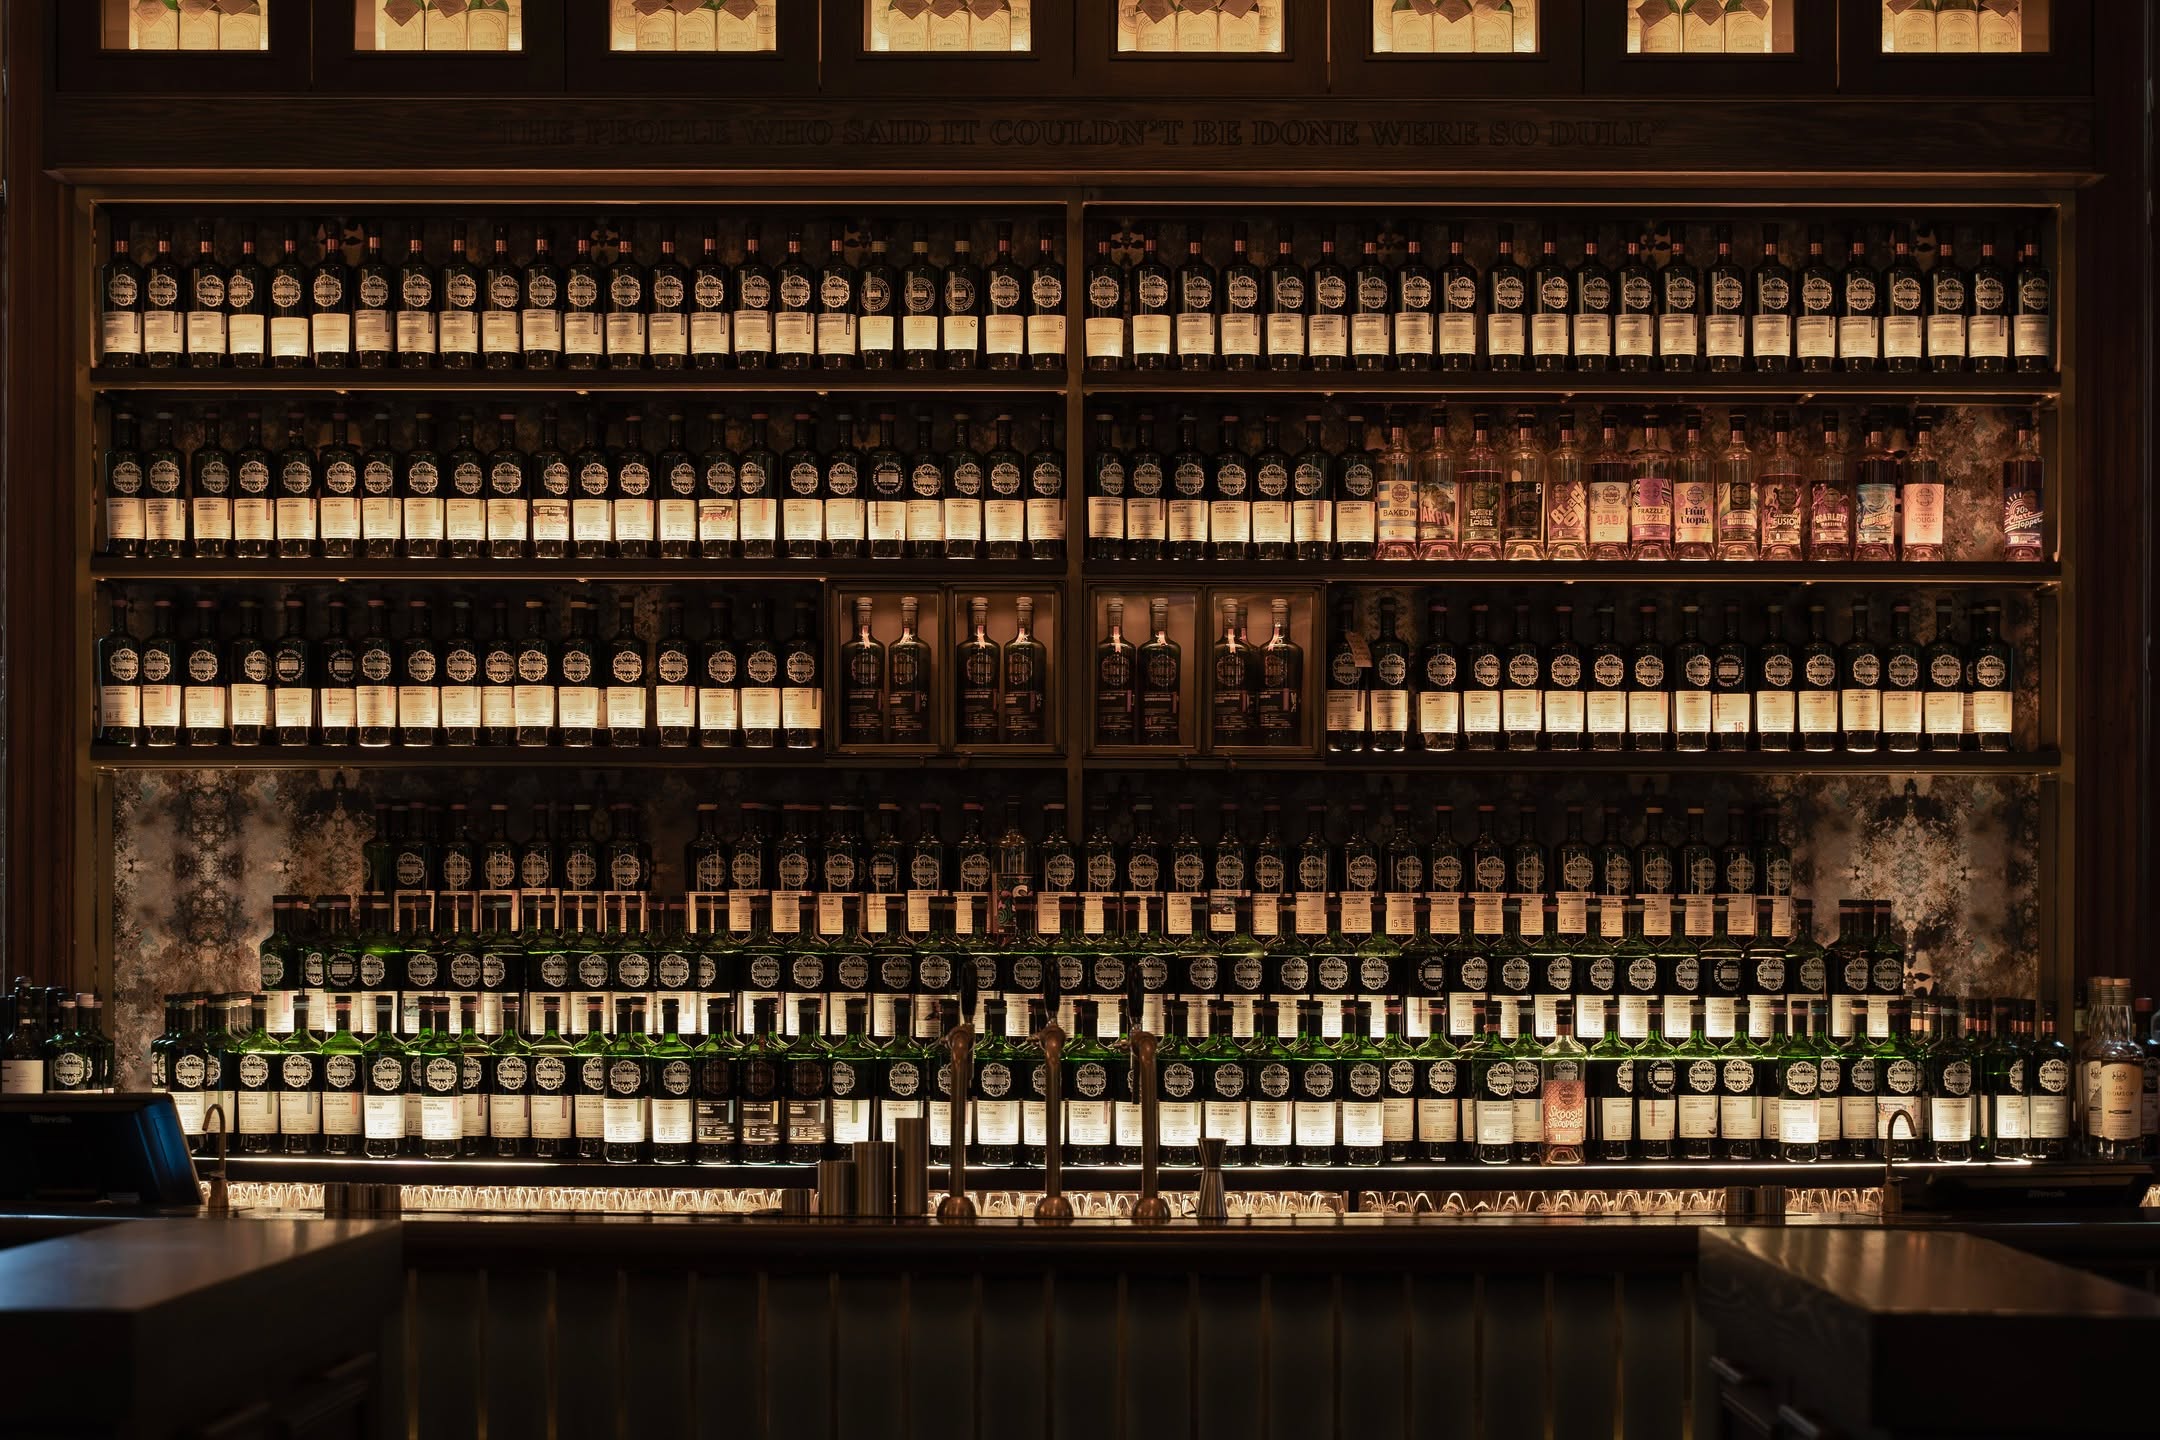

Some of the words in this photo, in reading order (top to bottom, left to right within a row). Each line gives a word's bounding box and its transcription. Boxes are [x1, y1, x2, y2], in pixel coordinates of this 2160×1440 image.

[585, 120, 730, 145] PEOPLE
[742, 120, 832, 145] WHO
[843, 120, 931, 145] SAID
[944, 120, 980, 145] IT
[1192, 120, 1242, 145] BE
[1252, 120, 1359, 145] DONE
[1368, 120, 1480, 145] WERE
[1488, 120, 1538, 145] SO
[1815, 513, 1847, 524] SCARLETT
[1734, 722, 1744, 731] 16
[1456, 1019, 1465, 1028] 20
